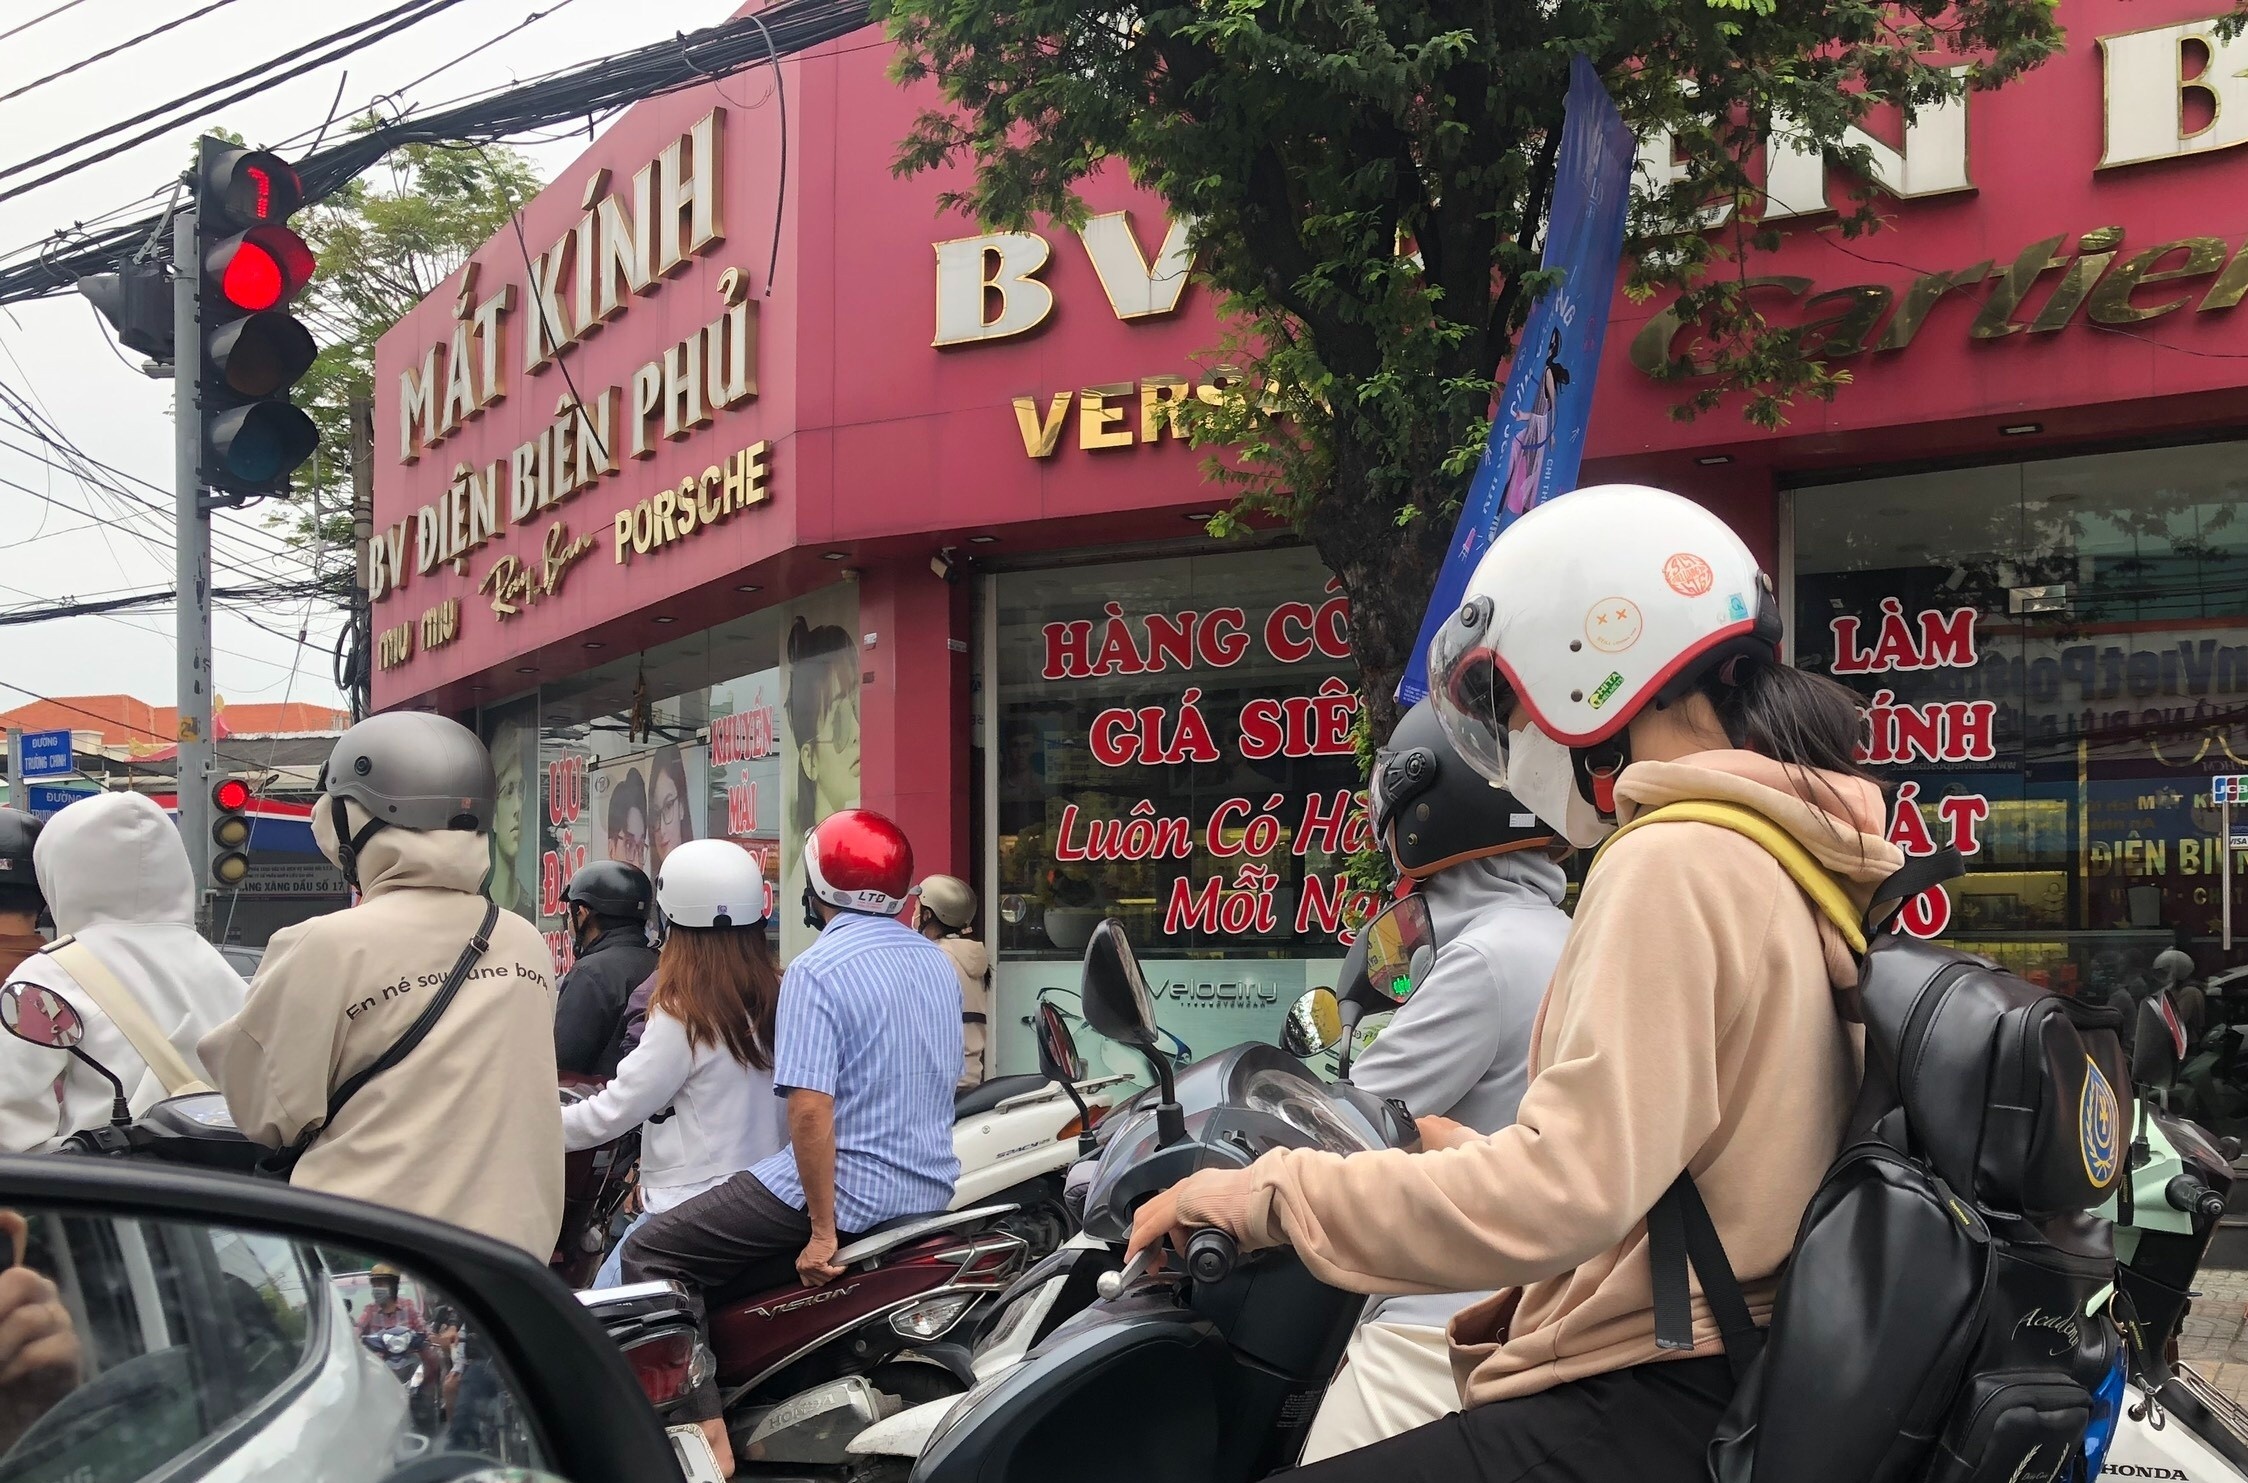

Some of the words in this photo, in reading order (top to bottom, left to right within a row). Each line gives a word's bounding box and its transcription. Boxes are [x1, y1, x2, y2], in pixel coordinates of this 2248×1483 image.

[400, 262, 517, 466] MẮT
[524, 106, 727, 375] KÍNH
[368, 515, 416, 603] BV
[416, 459, 506, 577] ĐIỆN
[510, 385, 622, 525] BIÊN
[614, 440, 771, 566] PORSCHE
[1041, 602, 1250, 680] HÀNG
[1830, 596, 1978, 675] LÀM
[1090, 687, 1220, 767] GIÁ
[1239, 676, 1360, 760] SIÊ
[1055, 799, 1193, 861] Luôn
[1206, 793, 1284, 858] Có
[1887, 780, 1990, 857] ÁT
[858, 891, 886, 903] LTD
[1164, 863, 1279, 935] Mỗi
[345, 996, 376, 1021] En
[382, 976, 411, 1000] né
[418, 971, 449, 988] sou
[467, 964, 508, 980] une
[744, 1283, 861, 1321] VISION
[2101, 1464, 2190, 1482] HONDA
